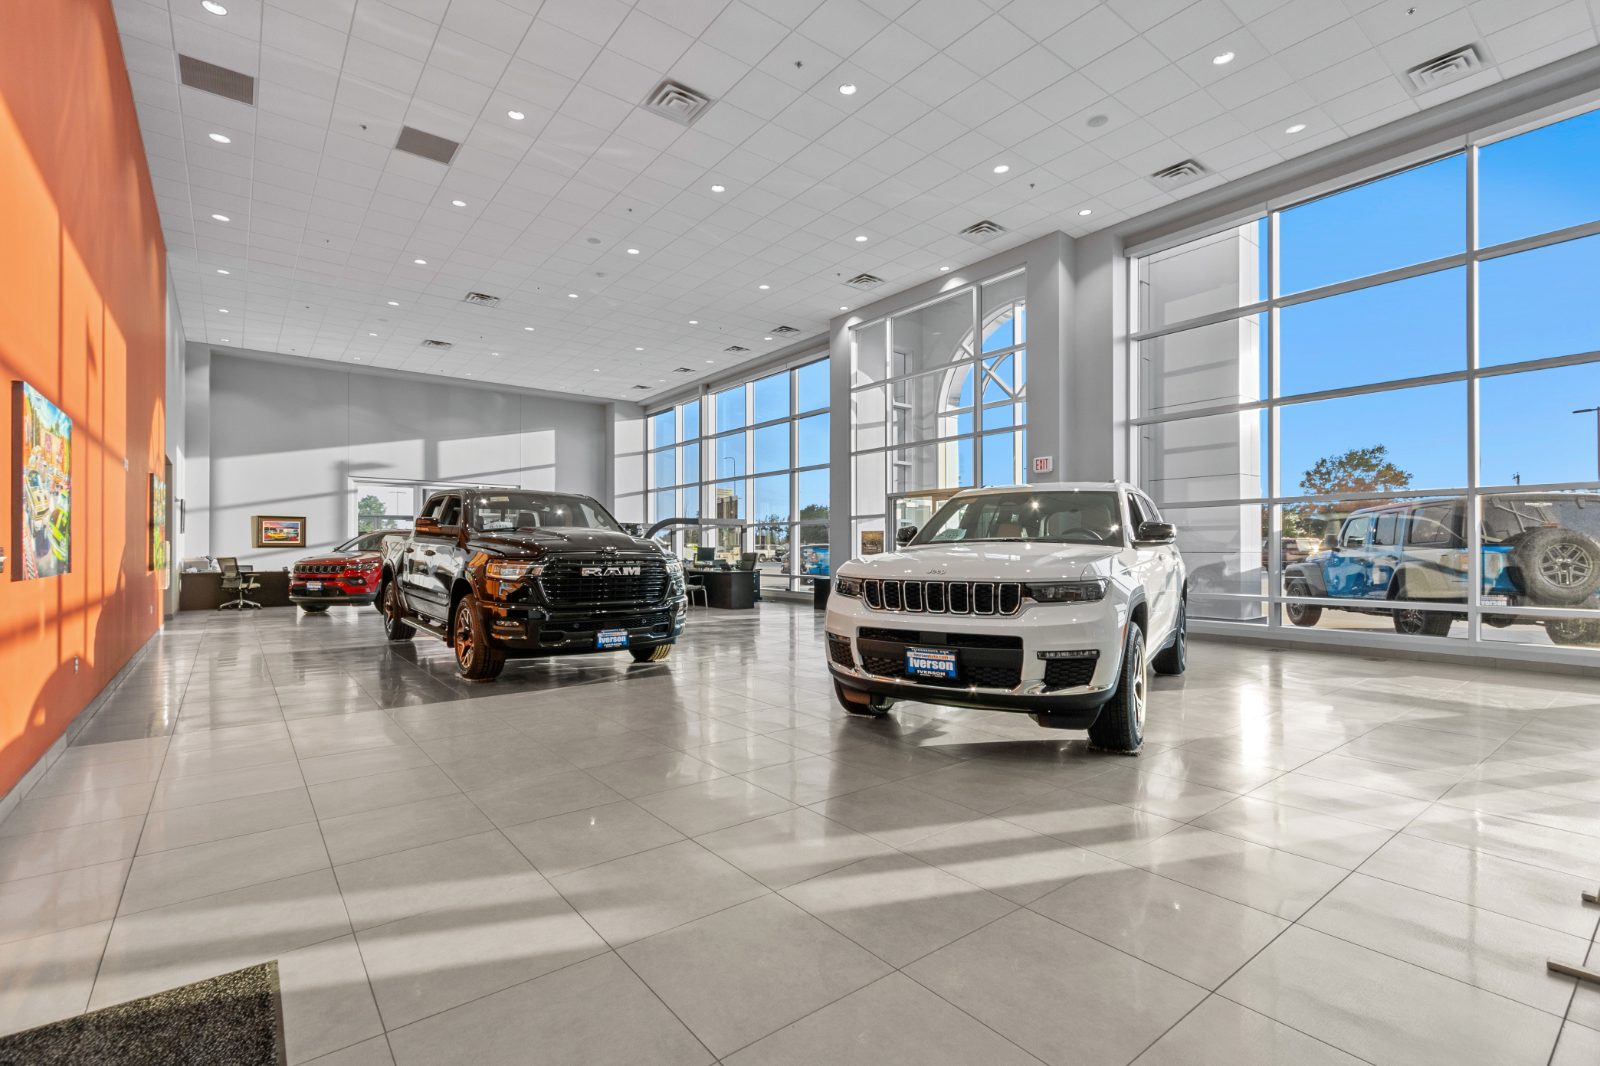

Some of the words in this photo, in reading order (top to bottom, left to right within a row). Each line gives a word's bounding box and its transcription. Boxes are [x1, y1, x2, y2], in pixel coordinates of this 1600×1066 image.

[1036, 459, 1048, 470] EXIT
[581, 567, 641, 576] RAM
[910, 657, 954, 671] Iverson
